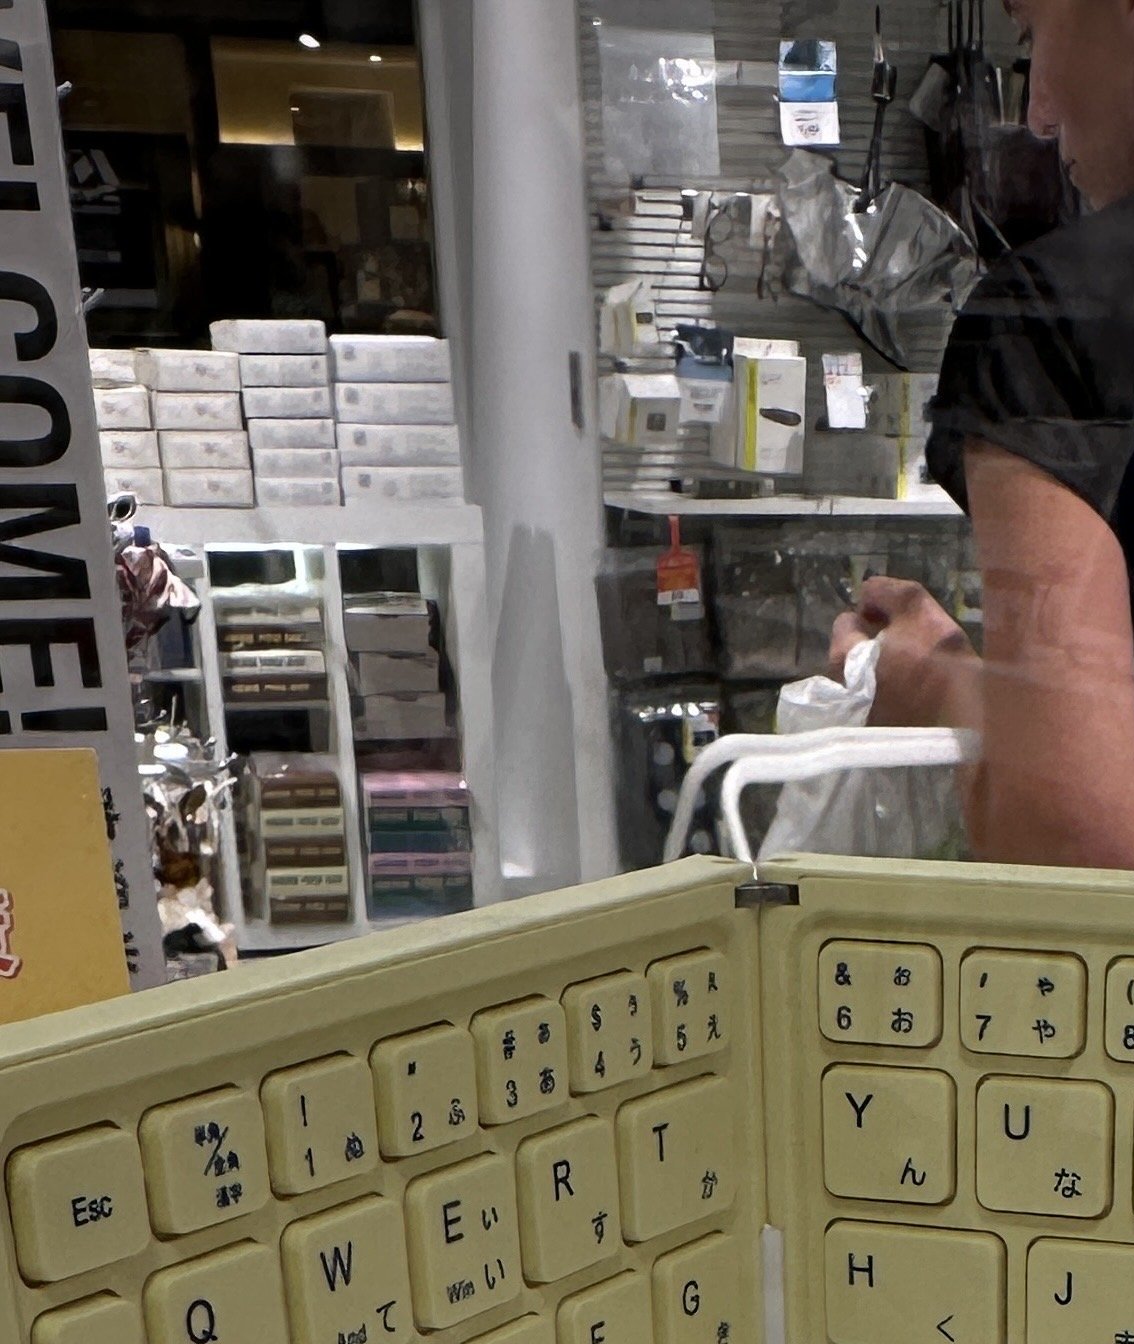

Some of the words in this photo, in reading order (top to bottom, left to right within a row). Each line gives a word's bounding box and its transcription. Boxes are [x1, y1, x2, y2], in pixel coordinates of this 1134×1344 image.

[0, 0, 108, 733] COME!
[834, 961, 853, 986] &
[836, 1005, 852, 1031] 6
[890, 1007, 914, 1034] お
[974, 1014, 992, 1042] 7
[1031, 1018, 1057, 1045] や
[676, 1023, 687, 1052] 5
[594, 1050, 606, 1078] 4
[505, 1079, 518, 1108] 3
[410, 1111, 425, 1142] 2
[844, 1092, 874, 1129] Y
[1003, 1103, 1031, 1141] U
[651, 1122, 670, 1163] T
[552, 1159, 575, 1202] R
[900, 1157, 927, 1187] ん
[1053, 1167, 1083, 1199] な
[70, 1195, 113, 1228] Esc
[442, 1199, 465, 1245] E
[319, 1240, 353, 1292] W
[847, 1252, 874, 1288] H
[682, 1279, 700, 1317] G
[1053, 1271, 1073, 1306] J
[375, 1300, 397, 1333] て
